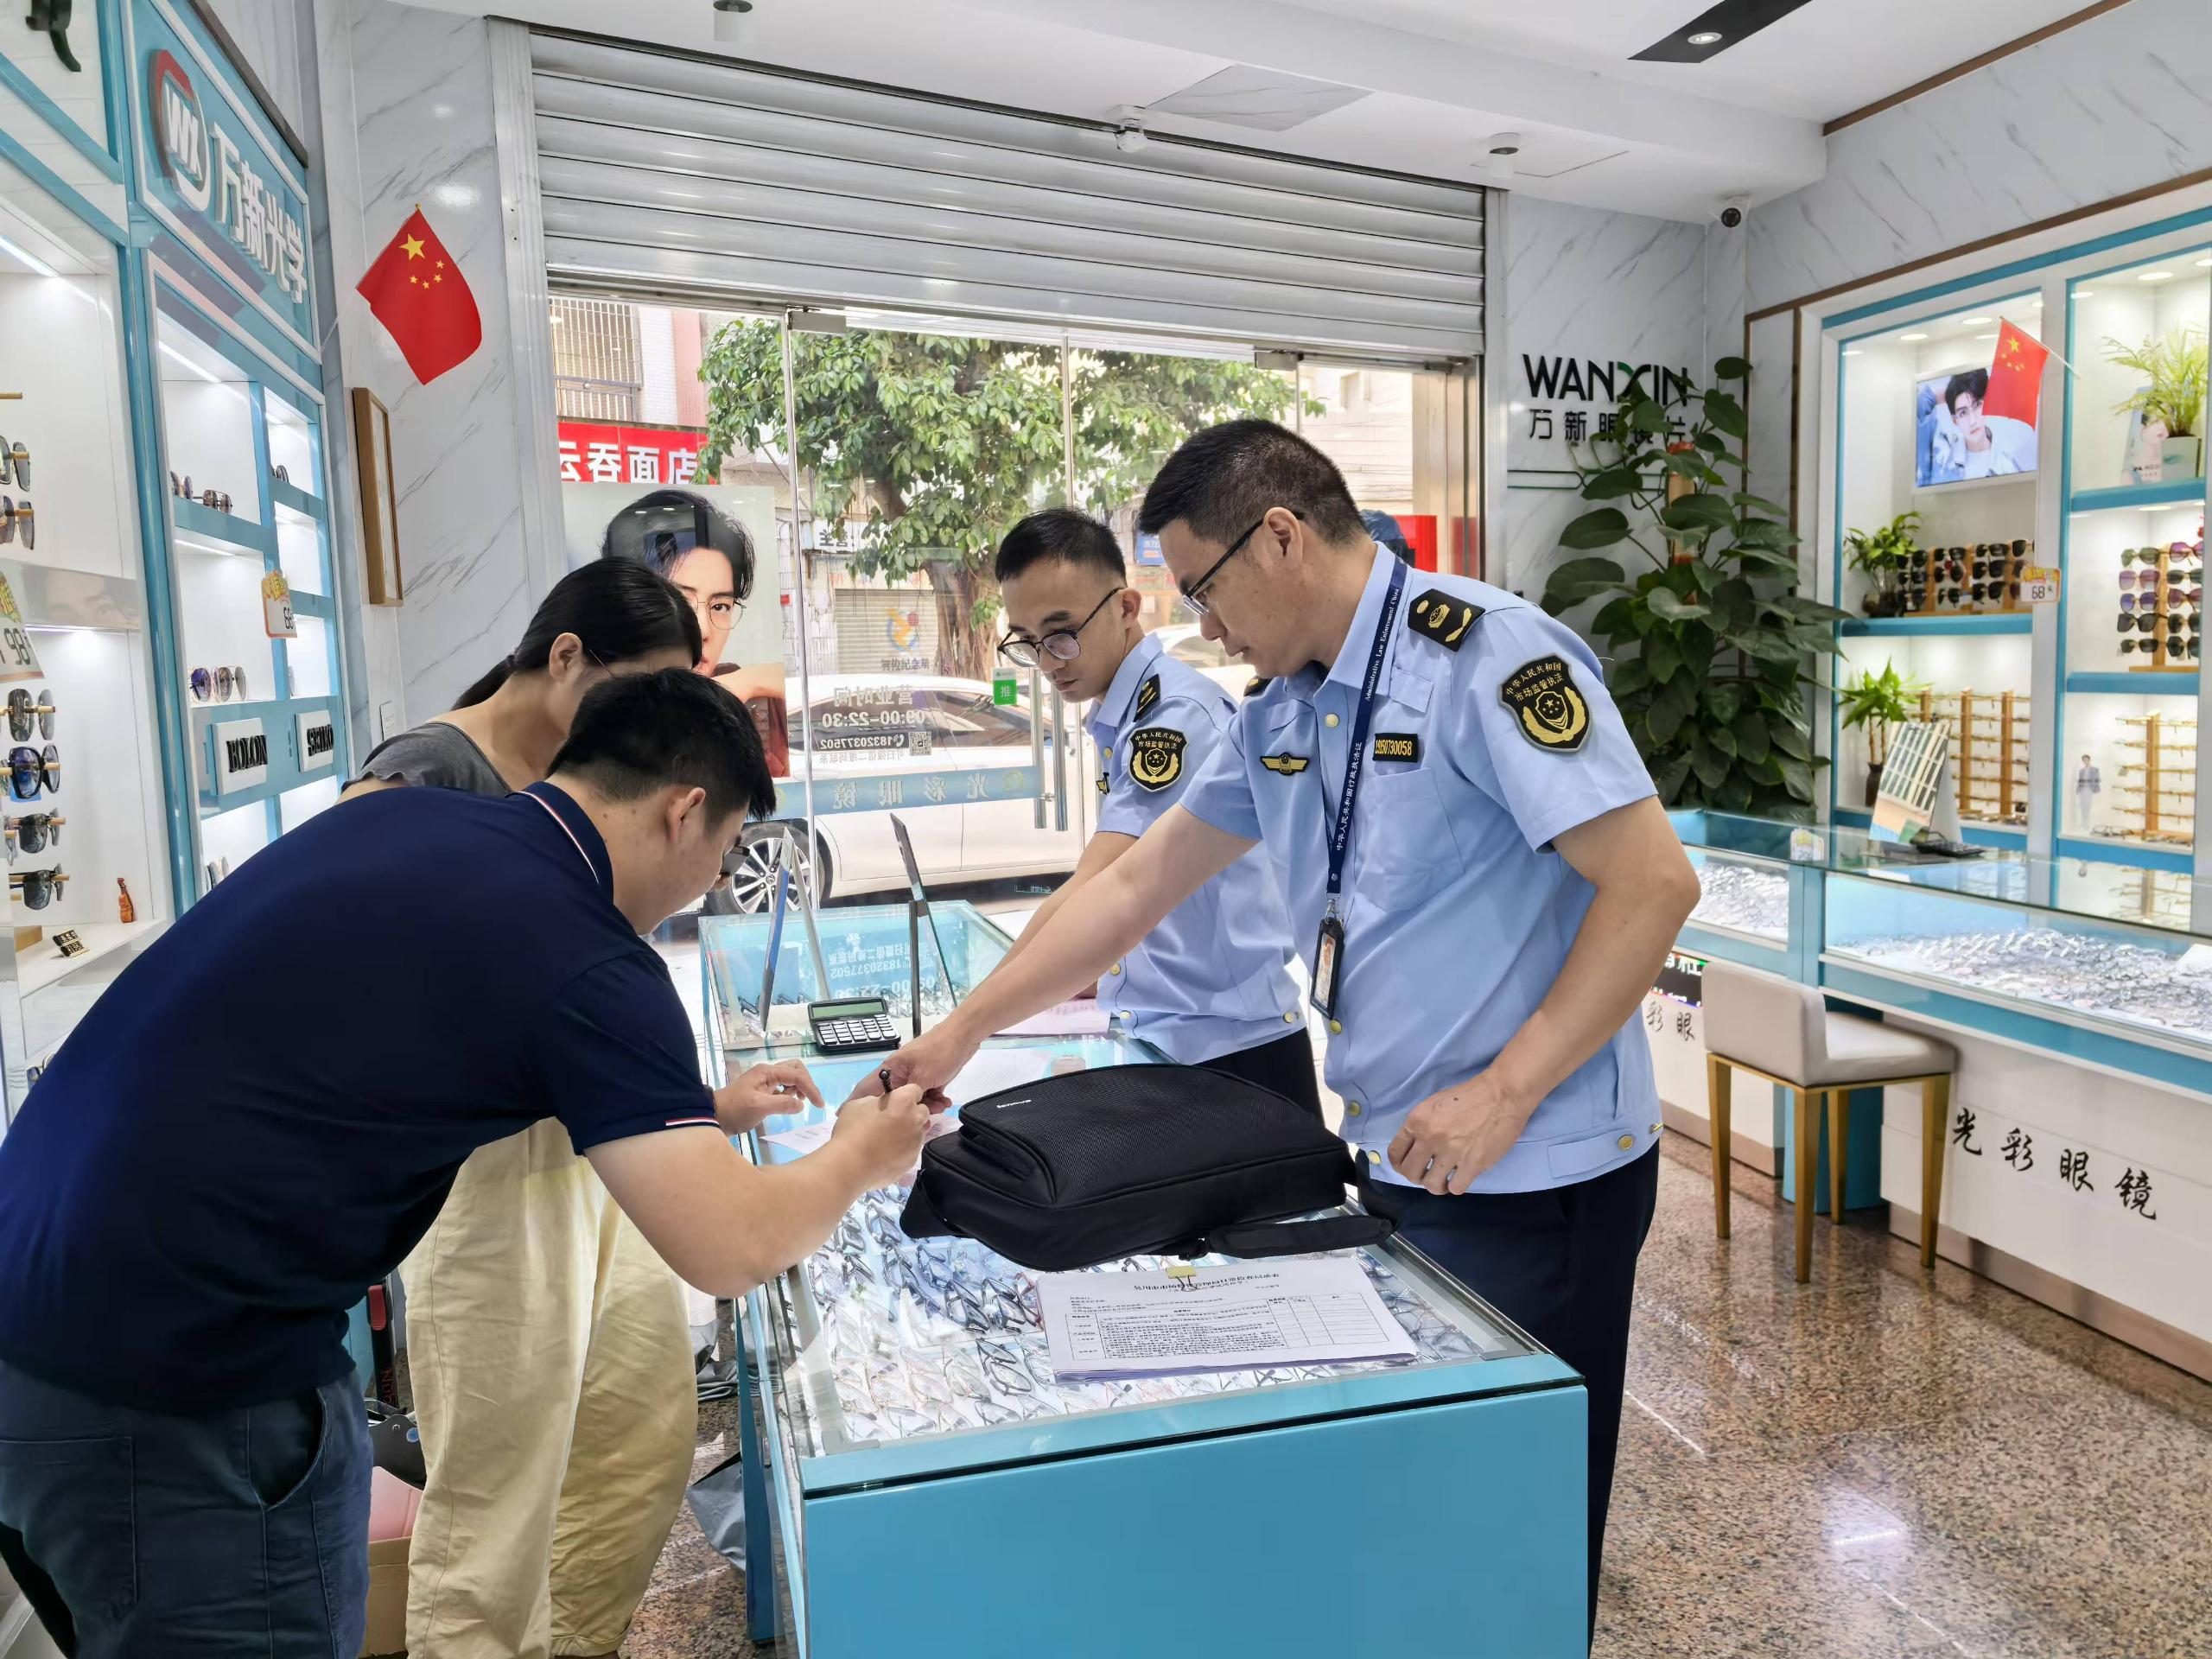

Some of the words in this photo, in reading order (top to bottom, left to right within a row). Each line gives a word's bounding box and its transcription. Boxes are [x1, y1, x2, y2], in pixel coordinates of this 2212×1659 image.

[209, 121, 308, 303] 万新光学
[1522, 353, 1688, 407] WANXIN
[1529, 408, 1687, 444] 万新眼片
[559, 441, 698, 485] 云吞面店
[2031, 585, 2045, 599] 68
[1364, 659, 1380, 702] Administrative
[1380, 607, 1395, 643] Enforcement
[1389, 588, 1400, 605] China
[1001, 684, 1012, 698] 推
[1506, 662, 1561, 696] 中华人民共和国
[1514, 672, 1564, 702] 市场监管执法
[226, 734, 268, 772] BOLON
[306, 724, 334, 757] SEIKO
[1135, 732, 1182, 743] 中华人民共和国
[1138, 741, 1177, 750] 市场监管执法
[1336, 741, 1363, 851] 中华人民共和国行政执法证
[1952, 1107, 2157, 1220] 光彩眼镜
